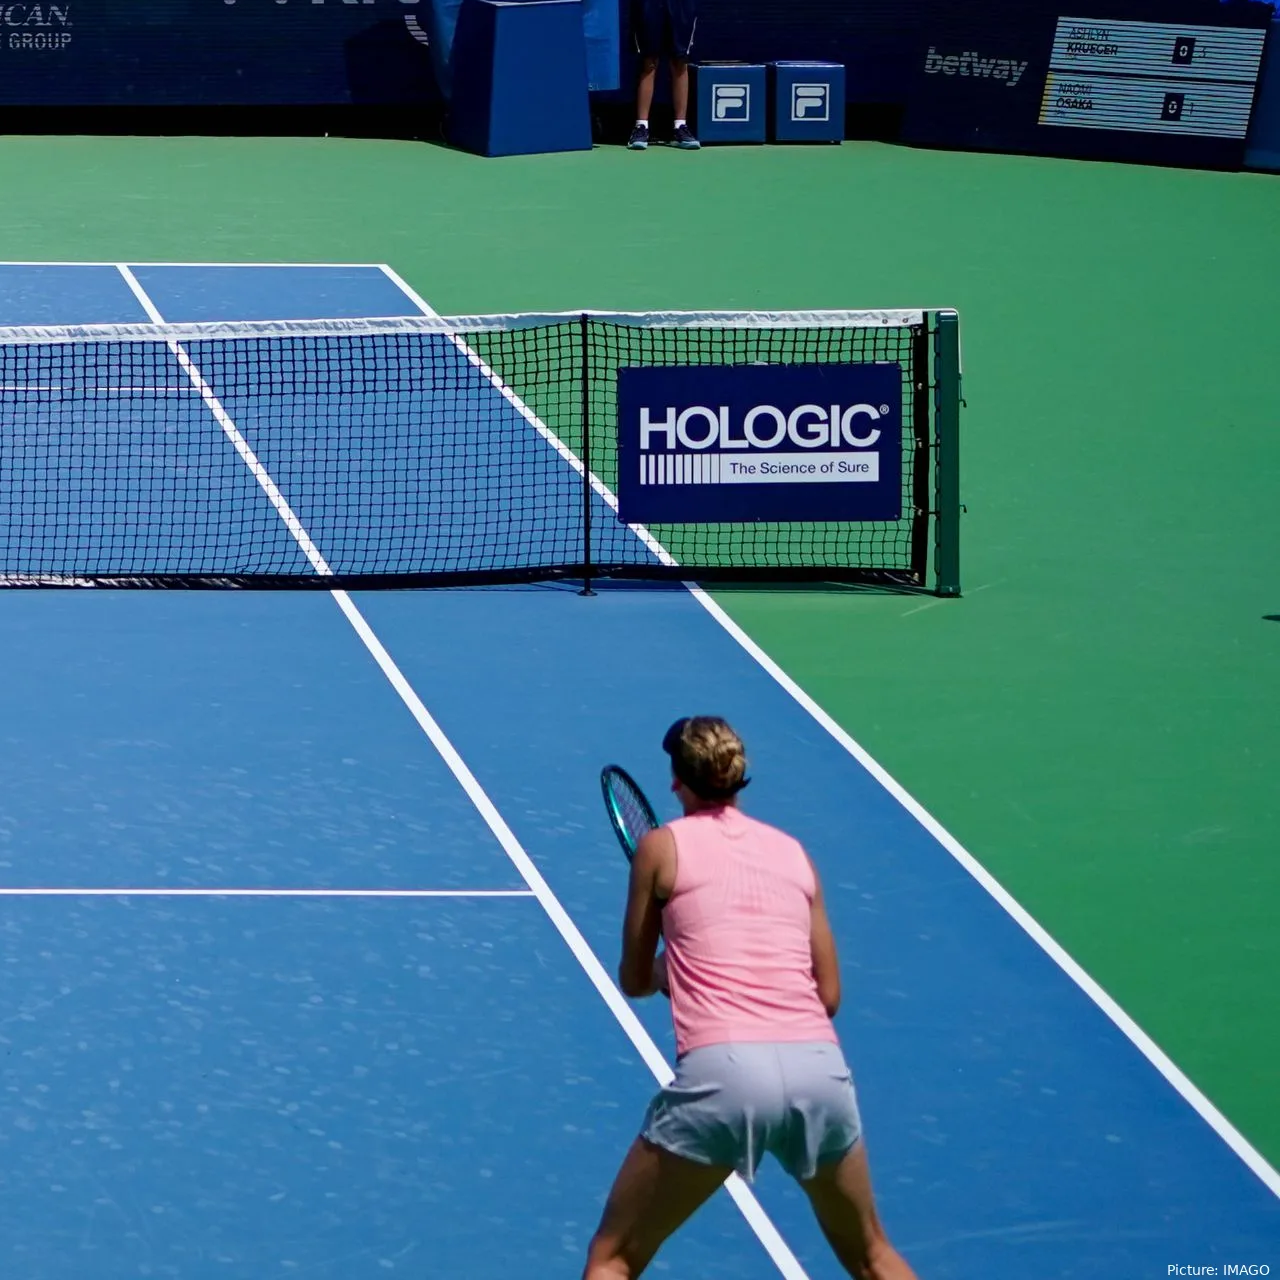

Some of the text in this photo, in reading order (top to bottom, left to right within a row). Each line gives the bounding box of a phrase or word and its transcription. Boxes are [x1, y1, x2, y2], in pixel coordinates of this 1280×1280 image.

[9, 32, 72, 50] GROUP
[1179, 46, 1188, 57] 0
[924, 46, 1028, 87] betway
[730, 461, 870, 475] The Science of Sure
